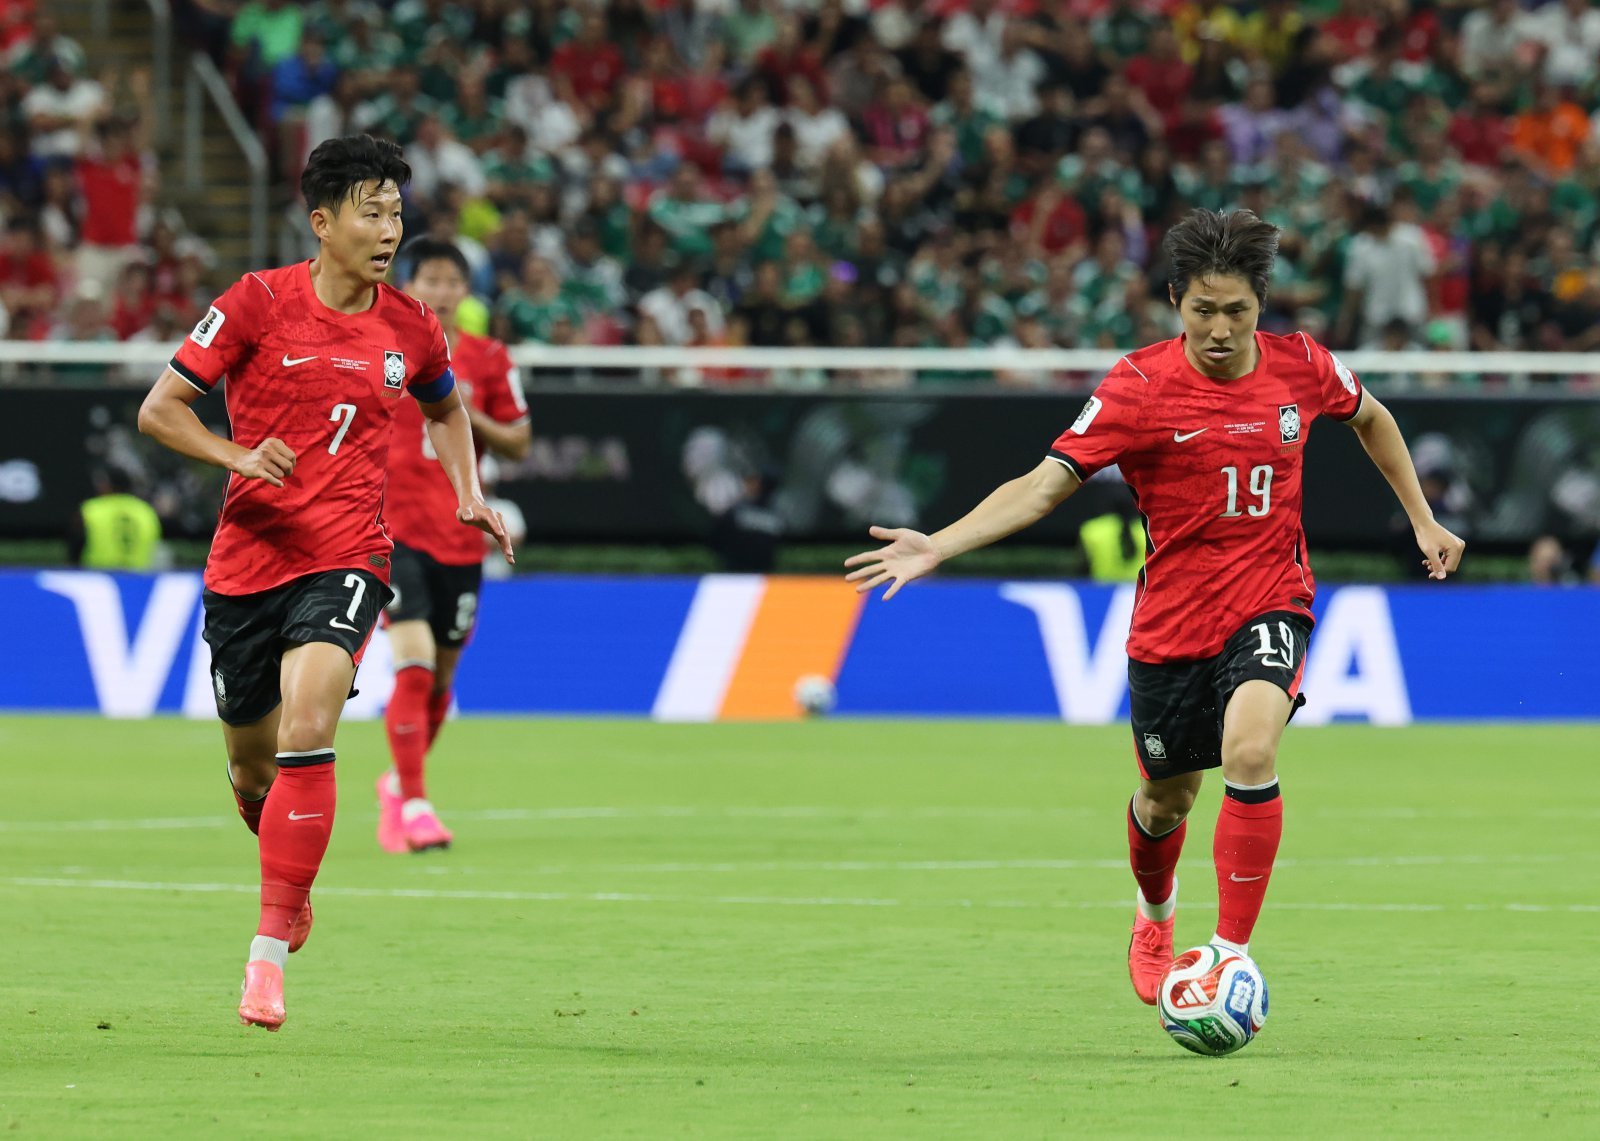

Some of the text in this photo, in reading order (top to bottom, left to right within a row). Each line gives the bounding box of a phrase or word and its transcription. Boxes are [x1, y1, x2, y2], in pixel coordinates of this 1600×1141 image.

[328, 403, 357, 456] 7
[1219, 464, 1274, 517] 19
[342, 573, 367, 623] 7
[999, 582, 1412, 724] VA
[1250, 620, 1294, 670] 19
